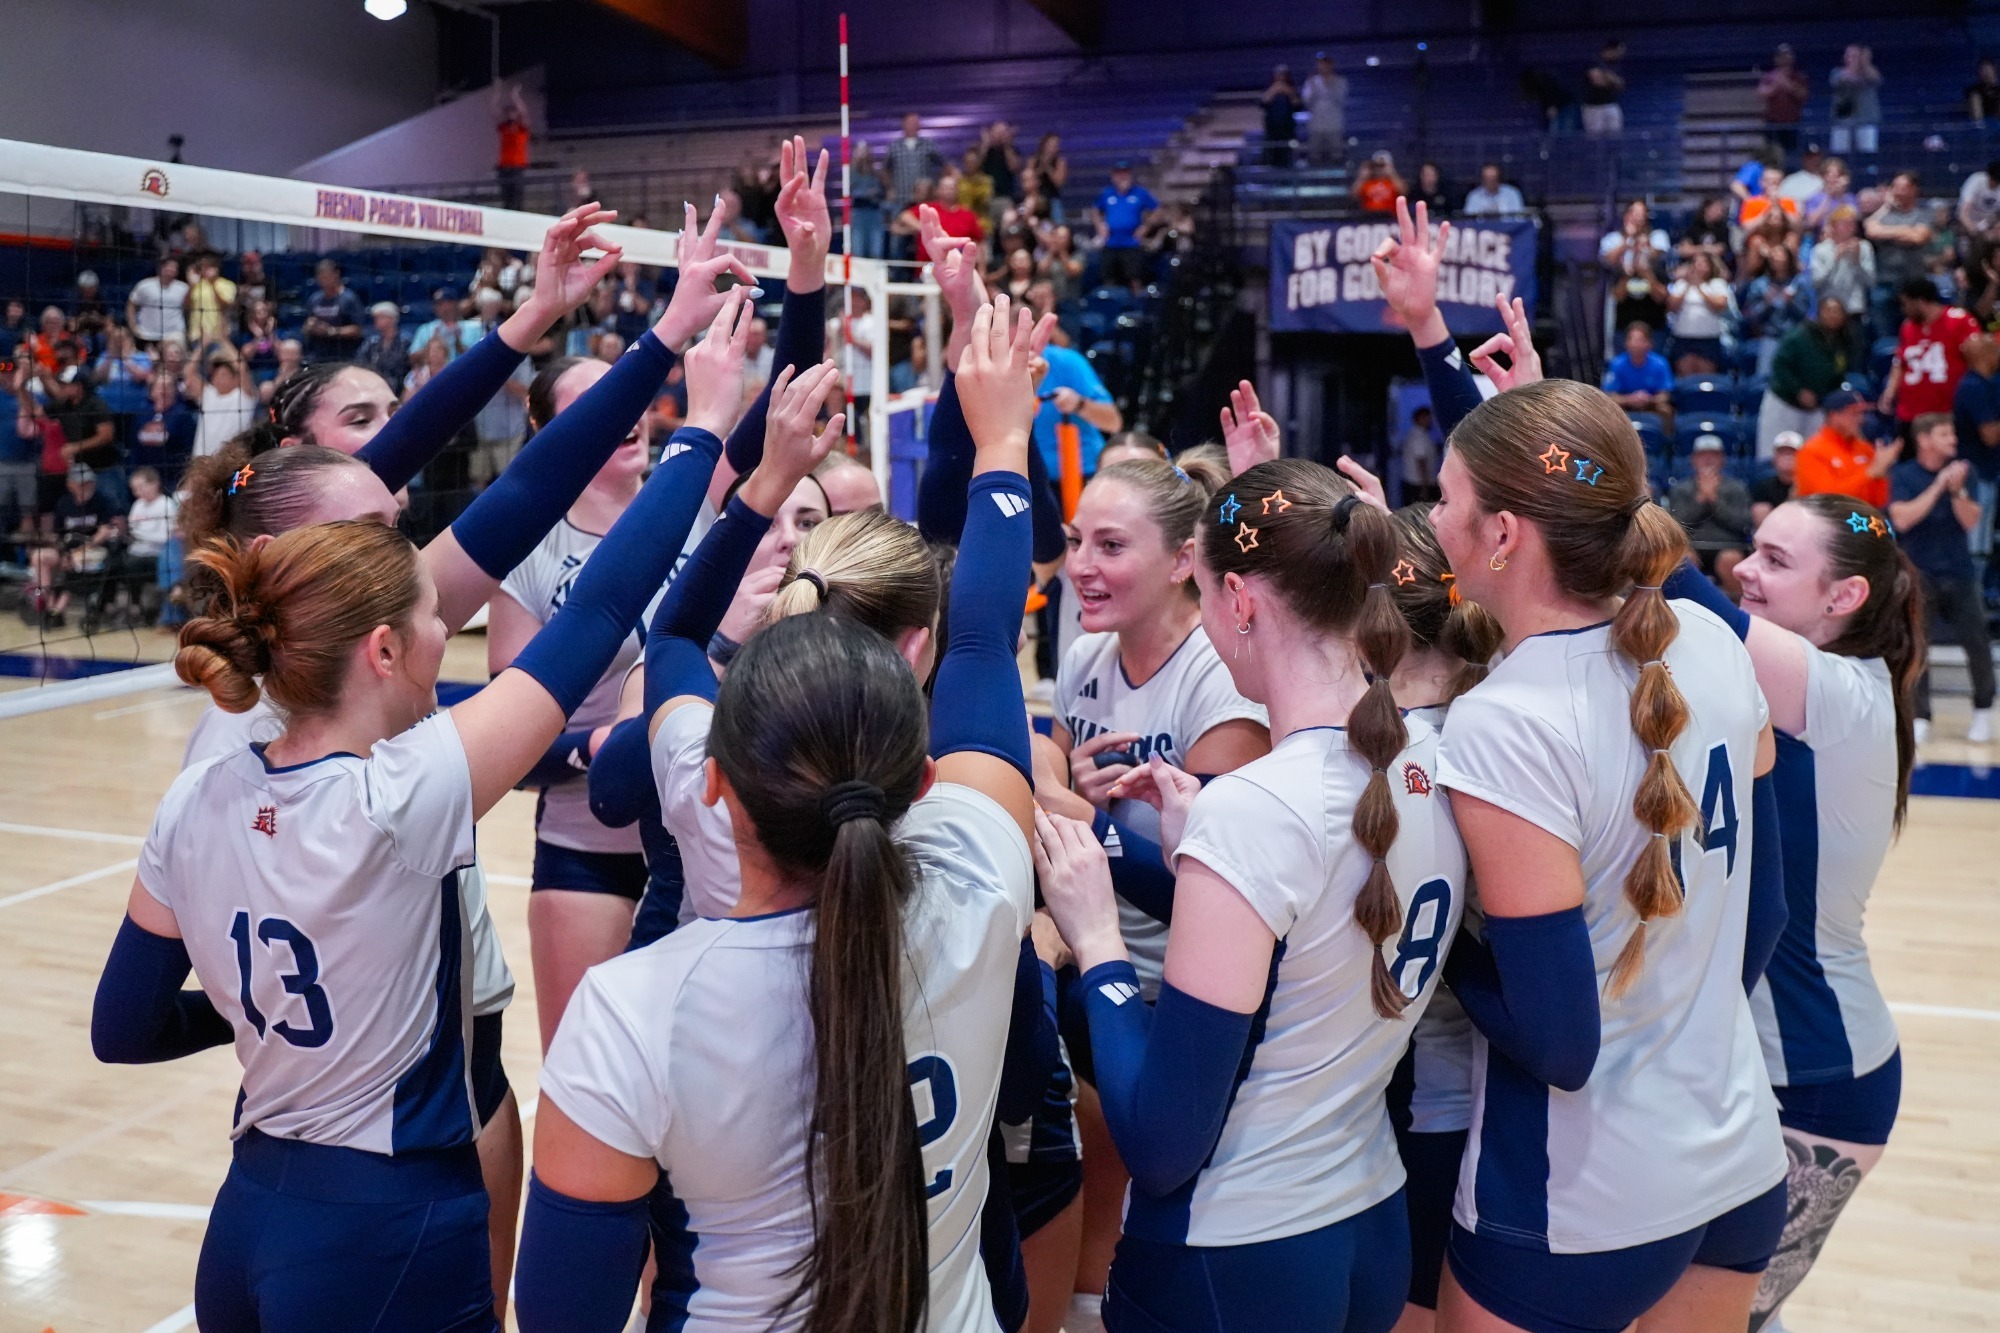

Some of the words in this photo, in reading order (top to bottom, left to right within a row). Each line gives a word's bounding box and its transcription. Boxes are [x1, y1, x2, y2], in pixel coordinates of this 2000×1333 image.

[369, 197, 416, 228] PACIFIC
[1294, 229, 1331, 271] BY
[1287, 267, 1338, 311] FOR
[1903, 340, 1949, 386] 54
[1388, 876, 1452, 1008] 8
[227, 909, 336, 1050] 13
